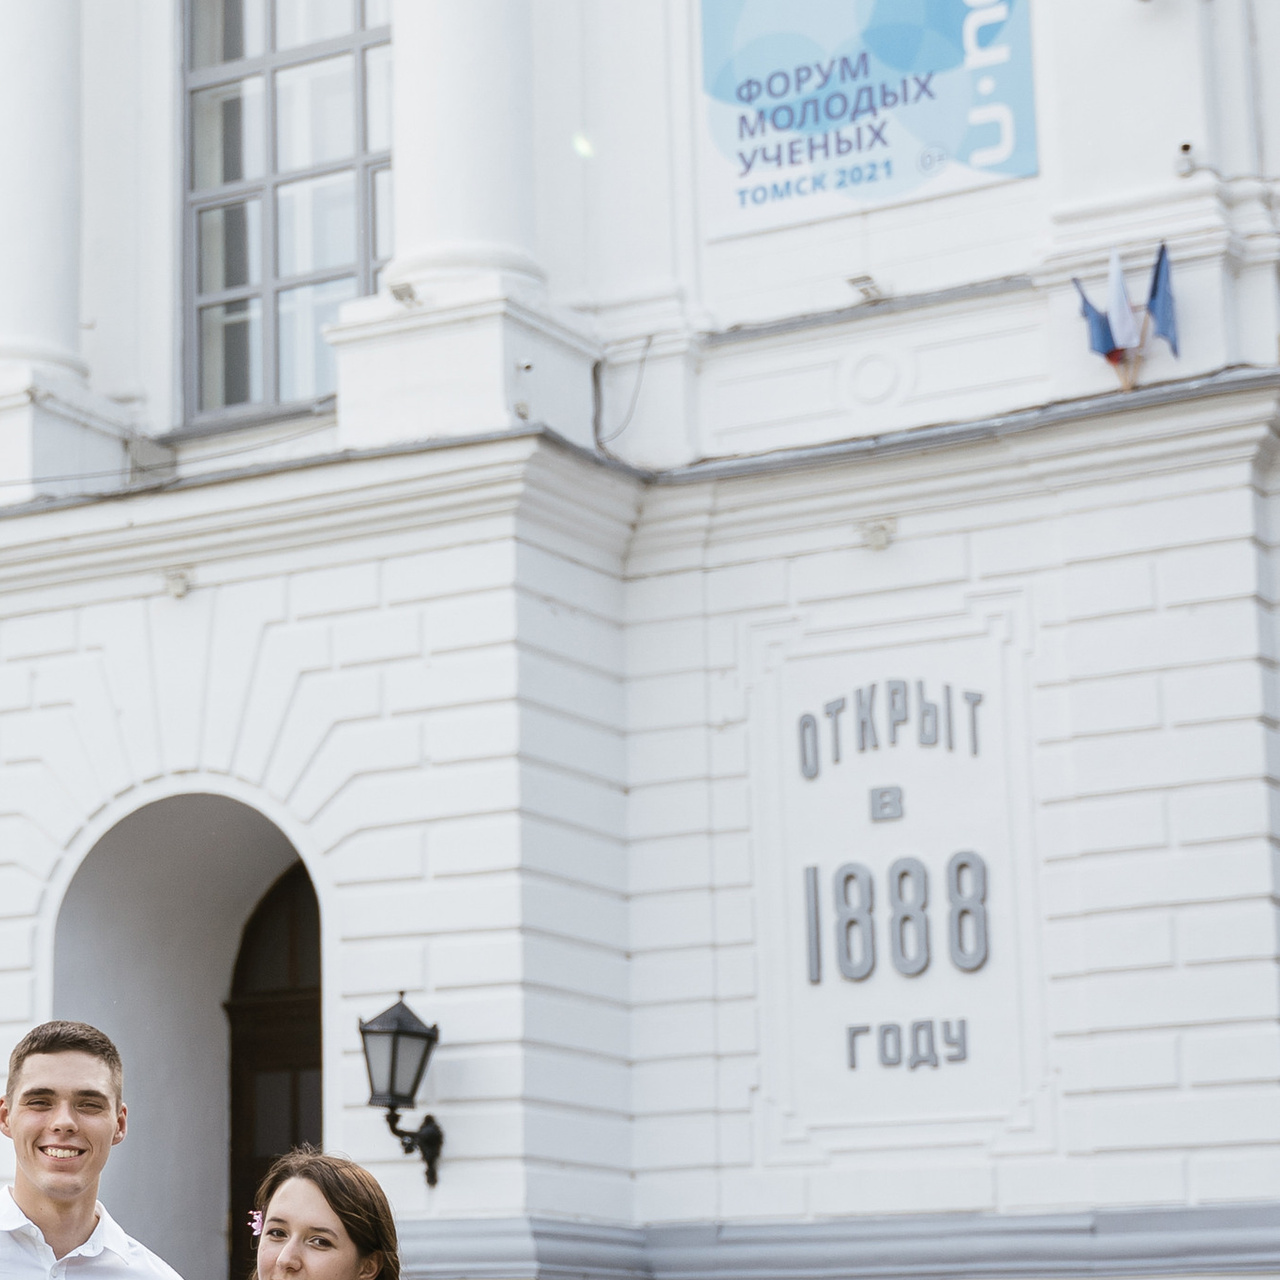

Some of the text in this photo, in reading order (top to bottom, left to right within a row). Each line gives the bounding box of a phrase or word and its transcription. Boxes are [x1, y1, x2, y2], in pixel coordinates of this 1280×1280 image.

[735, 51, 871, 105] ФОРУМ
[737, 72, 937, 141] МОЛОДЫХ
[738, 121, 889, 177] УЧЕНЫХ
[736, 160, 894, 208] ТОМСК 2021
[798, 679, 984, 781] ОТКРЫТ
[870, 786, 905, 823] В
[804, 850, 989, 985] 1888
[846, 1019, 968, 1070] ГОДУ
